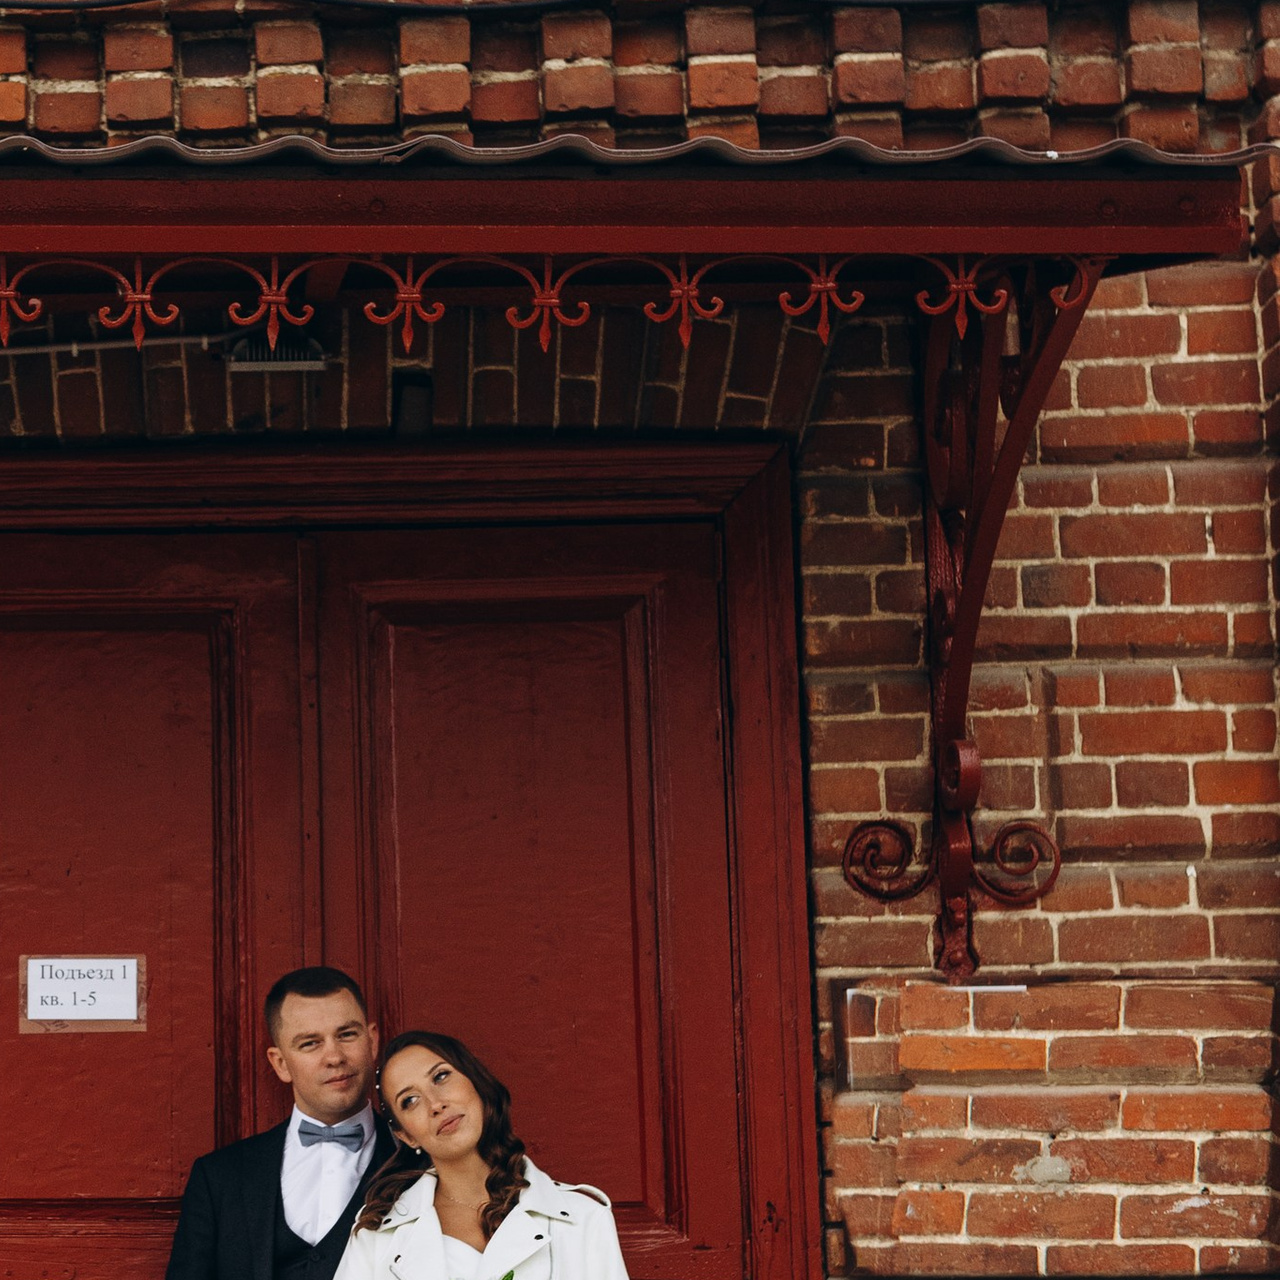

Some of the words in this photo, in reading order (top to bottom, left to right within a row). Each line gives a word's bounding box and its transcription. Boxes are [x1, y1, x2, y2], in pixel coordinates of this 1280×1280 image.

[40, 964, 115, 981] Подъезд
[122, 964, 128, 980] 1
[40, 995, 64, 1006] кв.
[73, 991, 97, 1006] 1-5
